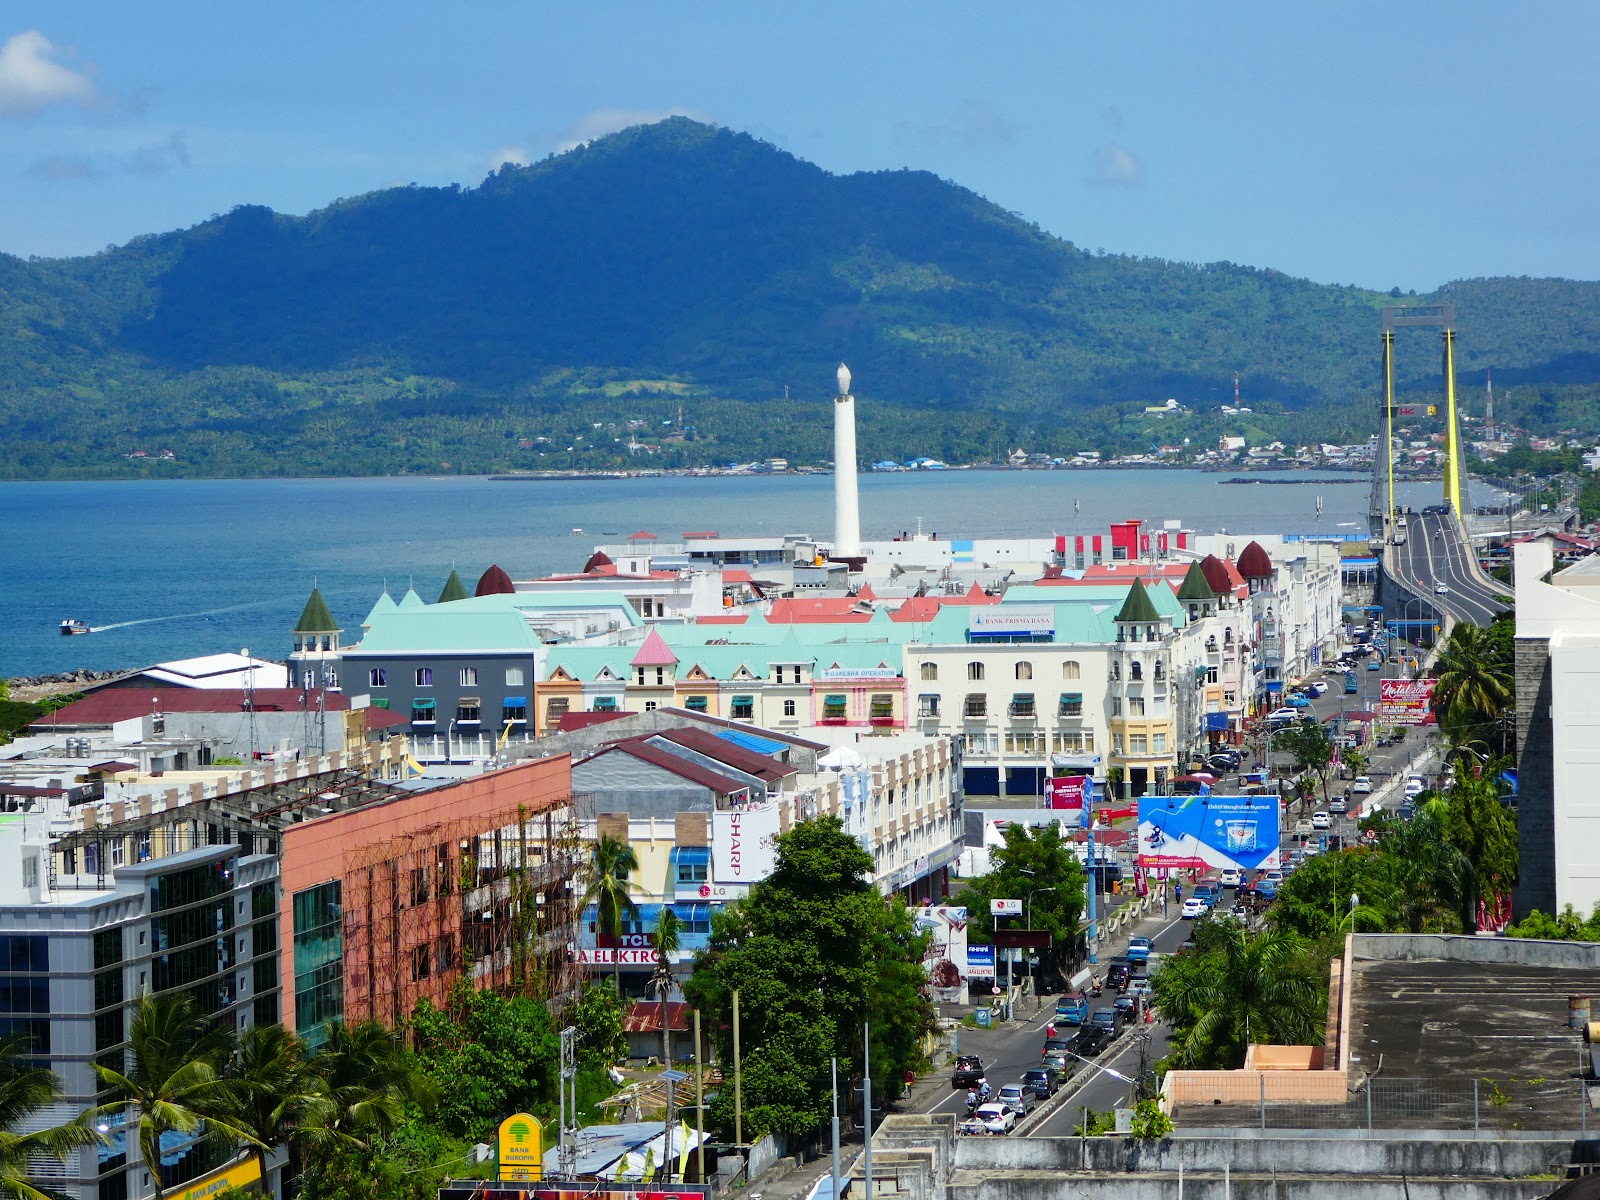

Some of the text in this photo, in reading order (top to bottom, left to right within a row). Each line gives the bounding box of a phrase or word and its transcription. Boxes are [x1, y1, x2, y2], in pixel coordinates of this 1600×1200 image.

[1382, 683, 1411, 698] Natal
[731, 812, 740, 876] SHARP
[621, 935, 652, 946] TCL
